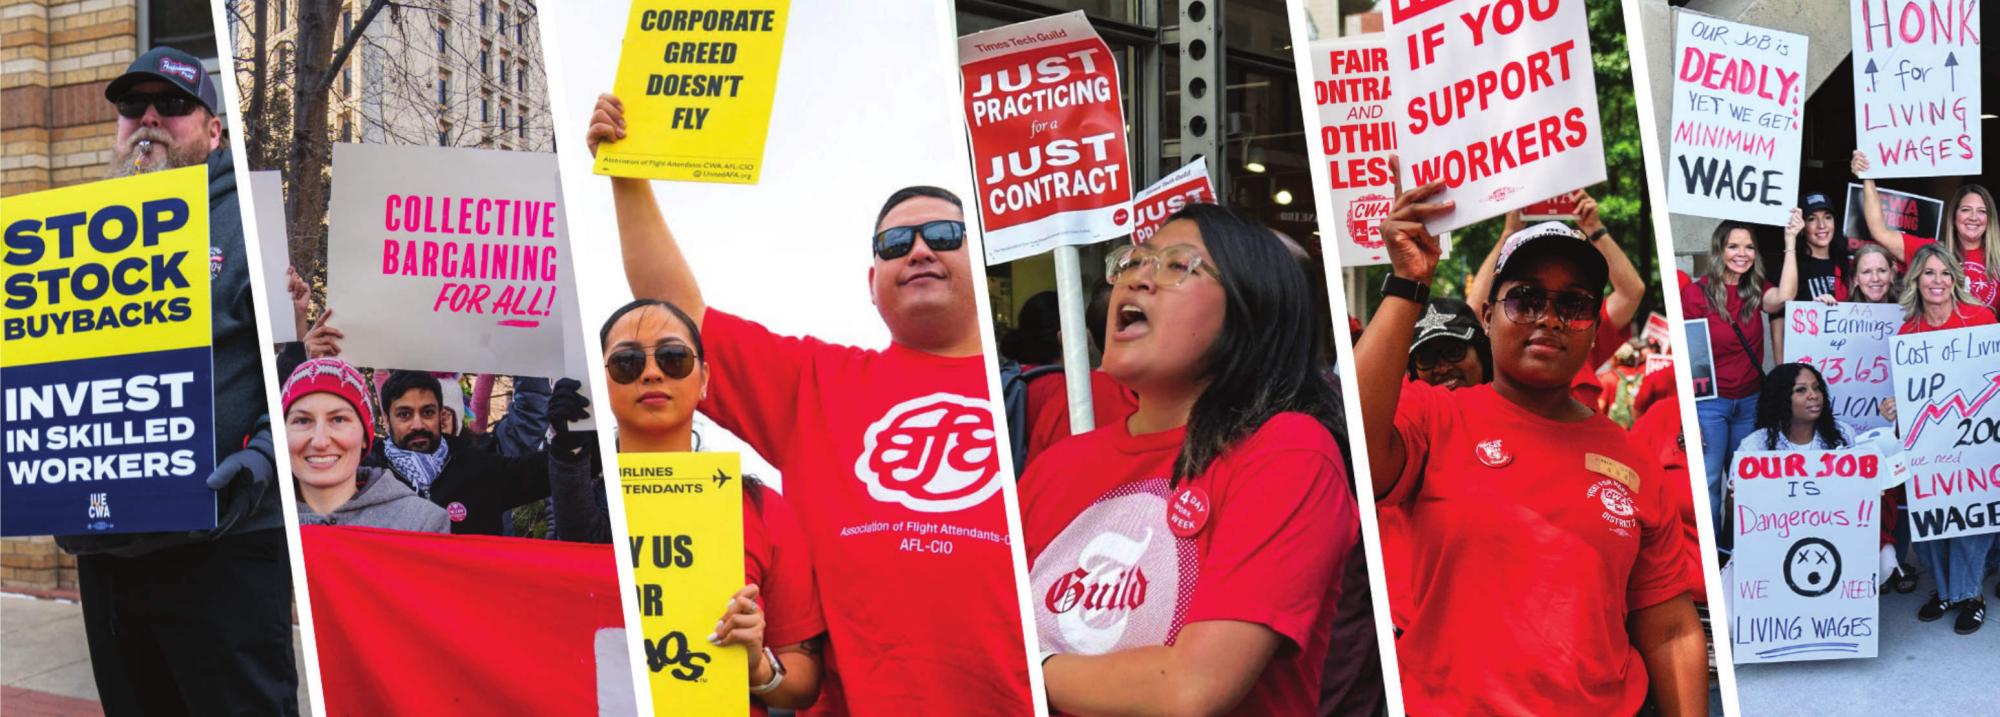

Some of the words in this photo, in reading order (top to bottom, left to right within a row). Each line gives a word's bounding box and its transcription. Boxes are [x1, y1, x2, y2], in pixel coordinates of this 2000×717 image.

[641, 9, 775, 32] CORPORATE
[1407, 22, 1445, 71] IF
[1460, 0, 1560, 47] YOU
[1691, 20, 1729, 46] OUR
[1862, 0, 1980, 52] HONK
[663, 41, 738, 64] GREED
[975, 41, 1010, 53] Times
[1008, 35, 1037, 46] Tech
[1036, 28, 1068, 42] Guild
[973, 48, 1100, 98] JUST
[1330, 47, 1389, 75] FAIR
[1679, 46, 1799, 107] DEADLY
[1894, 59, 1934, 92] for
[646, 74, 743, 97] DOESN'T
[973, 76, 1111, 127] PRACTICING
[1407, 39, 1574, 135] SUPPORT
[671, 107, 709, 129] FLY
[1346, 104, 1383, 120] AND
[1689, 90, 1725, 114] YET
[1729, 103, 1753, 123] WE
[1758, 111, 1793, 131] GET
[1865, 97, 1967, 132] LIVING
[1029, 120, 1048, 139] for
[1050, 120, 1059, 130] a
[1674, 120, 1775, 160] MINIMUM
[985, 132, 1115, 185] JUST
[1411, 106, 1588, 189] WORKERS
[1878, 134, 1974, 166] WAGES
[990, 164, 1120, 216] CONTRACT
[1678, 154, 1784, 206] WAGE
[385, 194, 556, 237] COLLECTIVE
[1135, 186, 1205, 227] JUST
[1355, 201, 1390, 218] CWA
[3, 197, 190, 267] STOP
[382, 239, 557, 281] BARGAINING
[4, 251, 191, 310] STOCK
[433, 283, 491, 314] FOR
[491, 284, 557, 316] ALL!
[4, 297, 192, 341] BUYBACKS
[1829, 338, 1847, 351] up
[1896, 339, 1934, 365] Cost
[1942, 338, 1962, 362] of
[5, 371, 194, 422] INVEST
[6, 429, 39, 453] IN
[46, 417, 195, 450] SKILLED
[8, 449, 197, 485] WORKERS
[1738, 453, 1808, 479] OUR
[1815, 453, 1879, 479] JOB
[1911, 455, 1929, 466] we
[1934, 451, 1962, 465] need
[90, 493, 107, 506] IUE
[1180, 490, 1191, 505] 4
[1190, 495, 1205, 512] DAY
[1787, 481, 1821, 498] IS
[88, 505, 110, 518] CWA
[1171, 513, 1195, 529] WEEK
[1738, 504, 1850, 538] Dangerous
[840, 520, 889, 537] Association
[892, 522, 903, 532] of
[906, 521, 938, 535] Flight
[652, 535, 694, 569] US
[900, 538, 953, 554] AFL-CIO
[1044, 565, 1150, 614] Guild
[1739, 579, 1770, 599] WE
[1840, 575, 1877, 599] NEED
[1736, 616, 1802, 645] LIVING
[1811, 616, 1873, 639] WAGES
